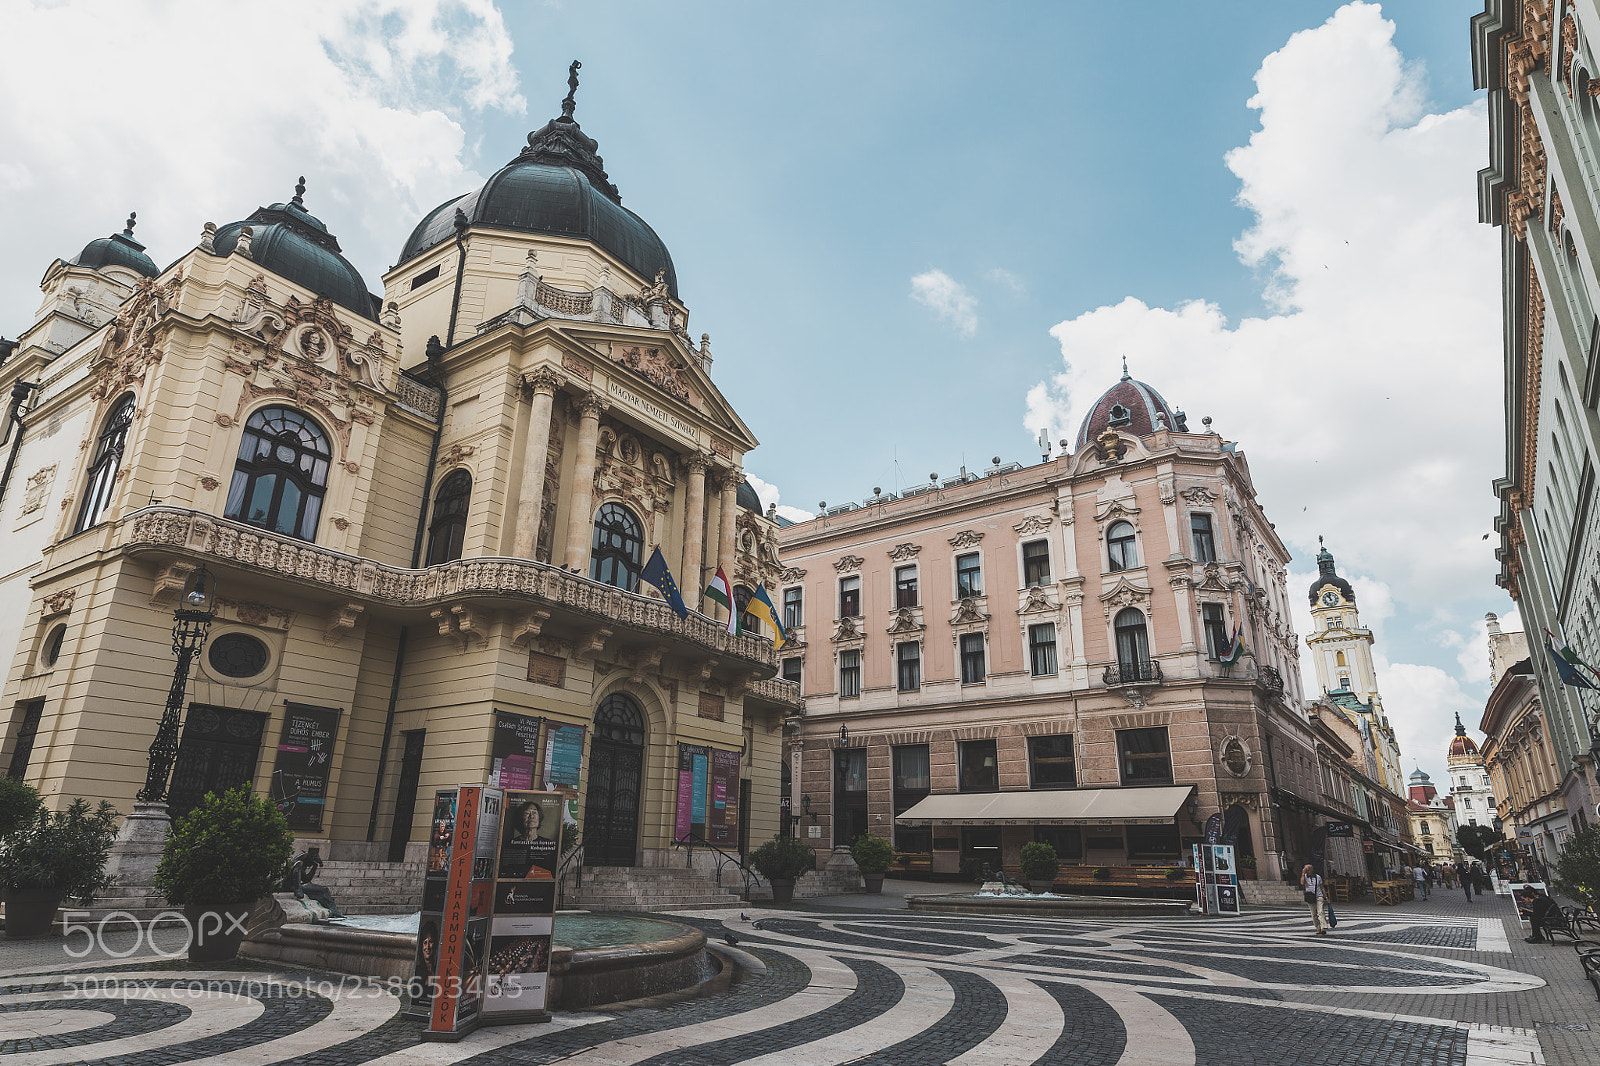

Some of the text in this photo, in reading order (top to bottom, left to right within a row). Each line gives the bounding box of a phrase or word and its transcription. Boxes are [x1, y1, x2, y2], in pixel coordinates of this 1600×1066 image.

[610, 383, 640, 407] MAGYAR
[641, 400, 668, 423] NEMZETI
[292, 720, 320, 732] TIZENKÉT
[311, 731, 330, 739] EMBER
[440, 788, 474, 1023] PANNON FILHARMONIKUSOK
